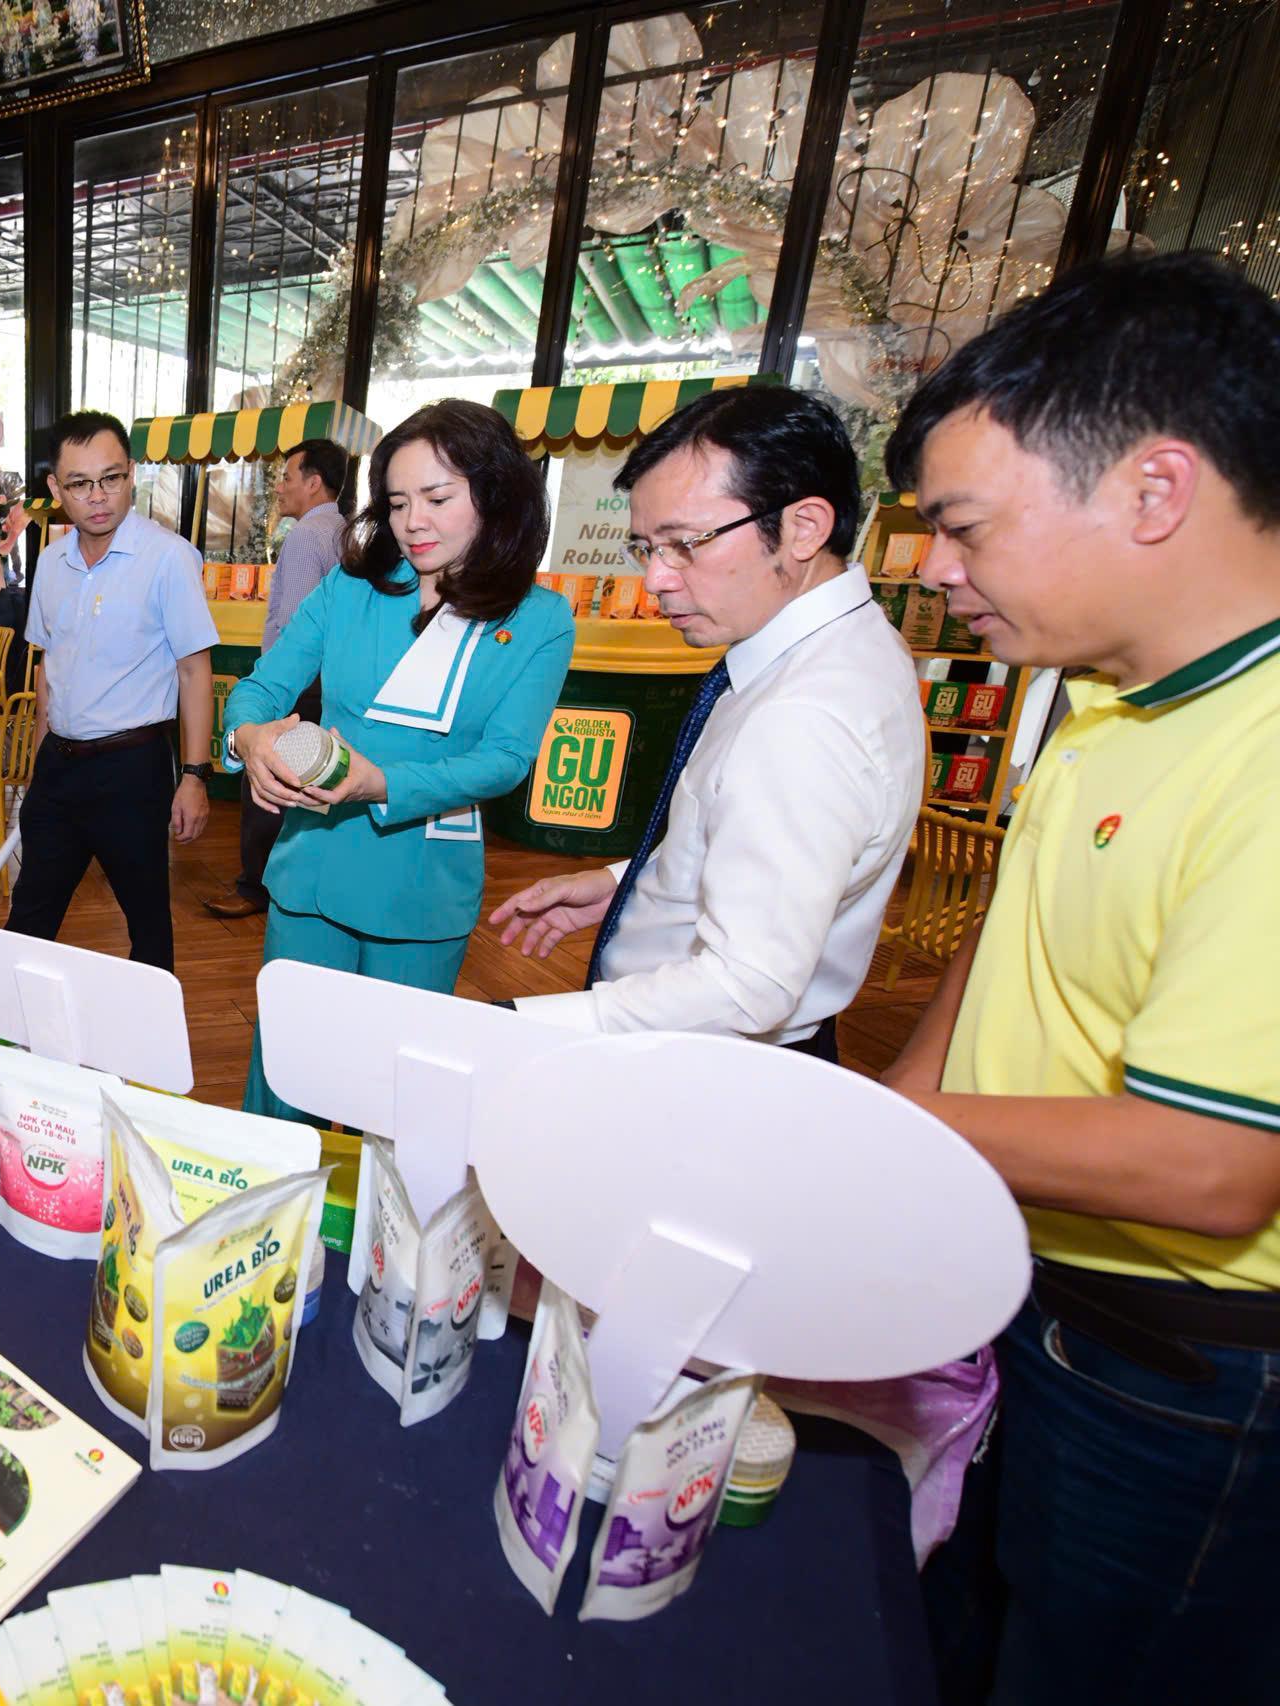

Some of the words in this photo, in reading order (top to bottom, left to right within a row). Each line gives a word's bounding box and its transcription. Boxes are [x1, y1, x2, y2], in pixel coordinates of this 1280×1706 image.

[562, 548, 627, 565] Robus
[936, 691, 959, 707] GU
[971, 694, 996, 710] GU
[574, 718, 611, 729] GOLDEN
[574, 726, 616, 738] ROBUSTA
[547, 735, 615, 788] GU
[957, 767, 979, 782] GU
[542, 783, 607, 813] NGON
[16, 1120, 41, 1134] GOLD
[19, 1113, 38, 1125] NPK
[55, 1123, 75, 1136] MAU
[26, 1154, 66, 1175] NPK
[171, 1159, 214, 1181] UREA
[218, 1169, 248, 1190] BIO
[204, 1259, 247, 1299] UREA
[251, 1230, 281, 1269] BIO
[455, 1272, 484, 1320] NPK
[528, 1401, 544, 1454] NPK
[671, 1470, 717, 1515] NPK
